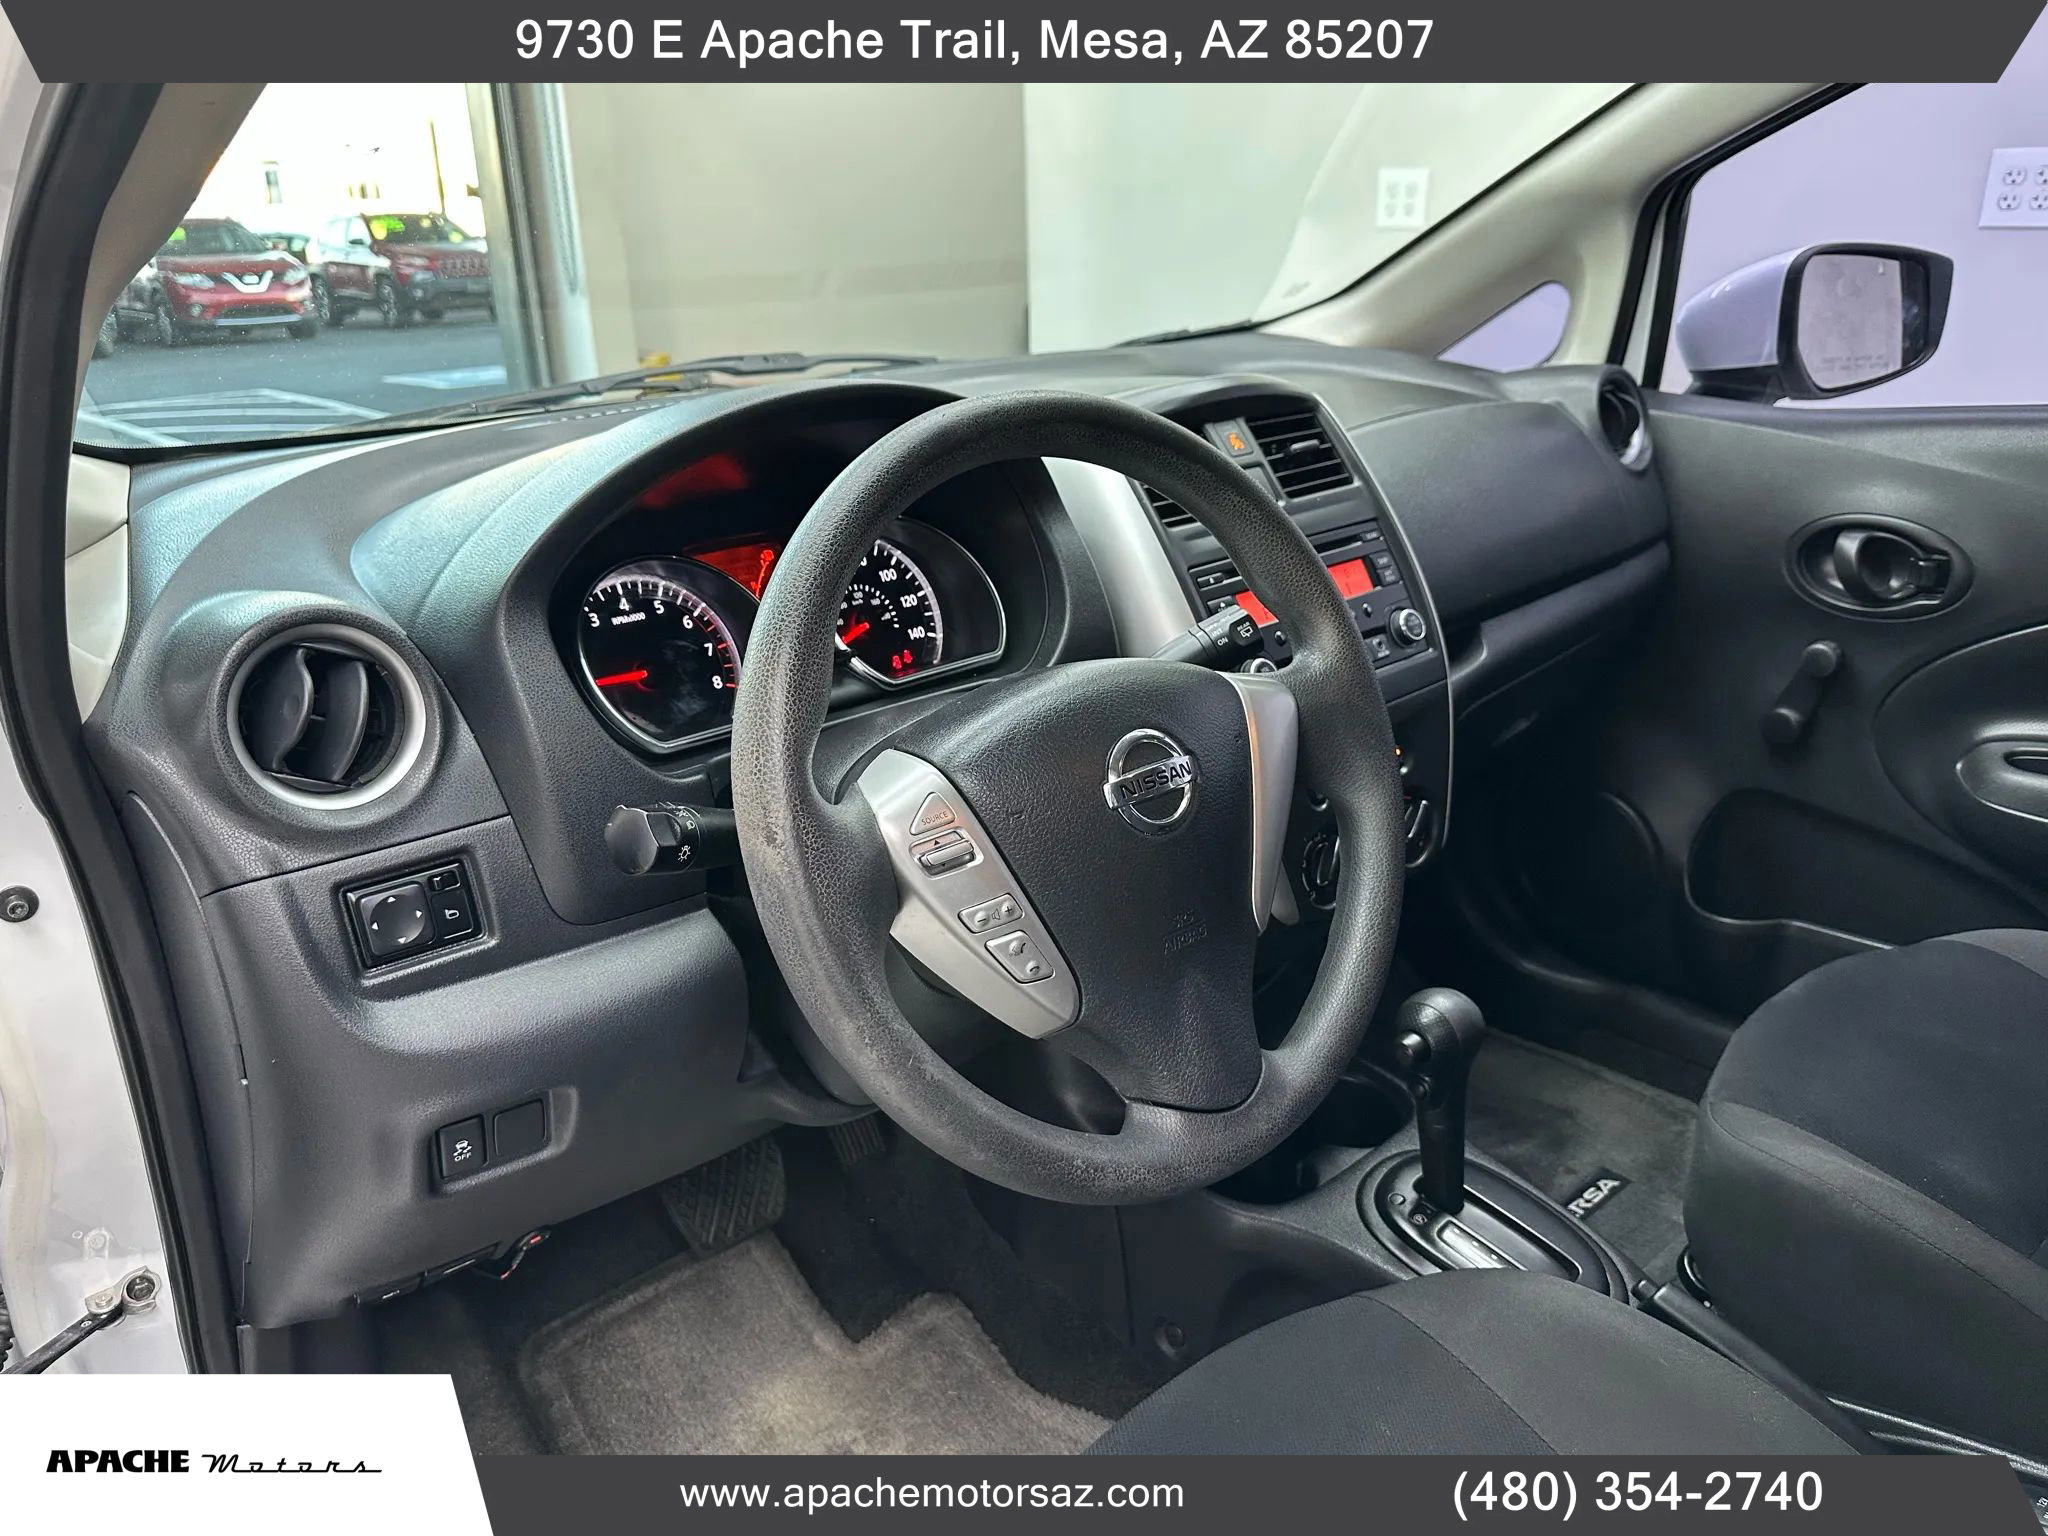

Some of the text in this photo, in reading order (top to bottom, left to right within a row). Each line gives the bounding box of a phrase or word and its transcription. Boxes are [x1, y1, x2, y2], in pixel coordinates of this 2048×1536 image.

[879, 568, 897, 582] 100
[619, 597, 630, 611] 4
[653, 600, 665, 614] 5
[900, 594, 918, 608] 120
[588, 613, 600, 627] 3
[682, 615, 693, 629] 6
[907, 626, 926, 640] 140
[1217, 636, 1229, 646] ON
[703, 643, 713, 656] 7
[711, 675, 723, 689] 8
[1119, 760, 1193, 800] NISSAN
[921, 810, 949, 826] SOURCE
[454, 1151, 472, 1162] OFF
[1567, 1179, 1621, 1218] RSA
